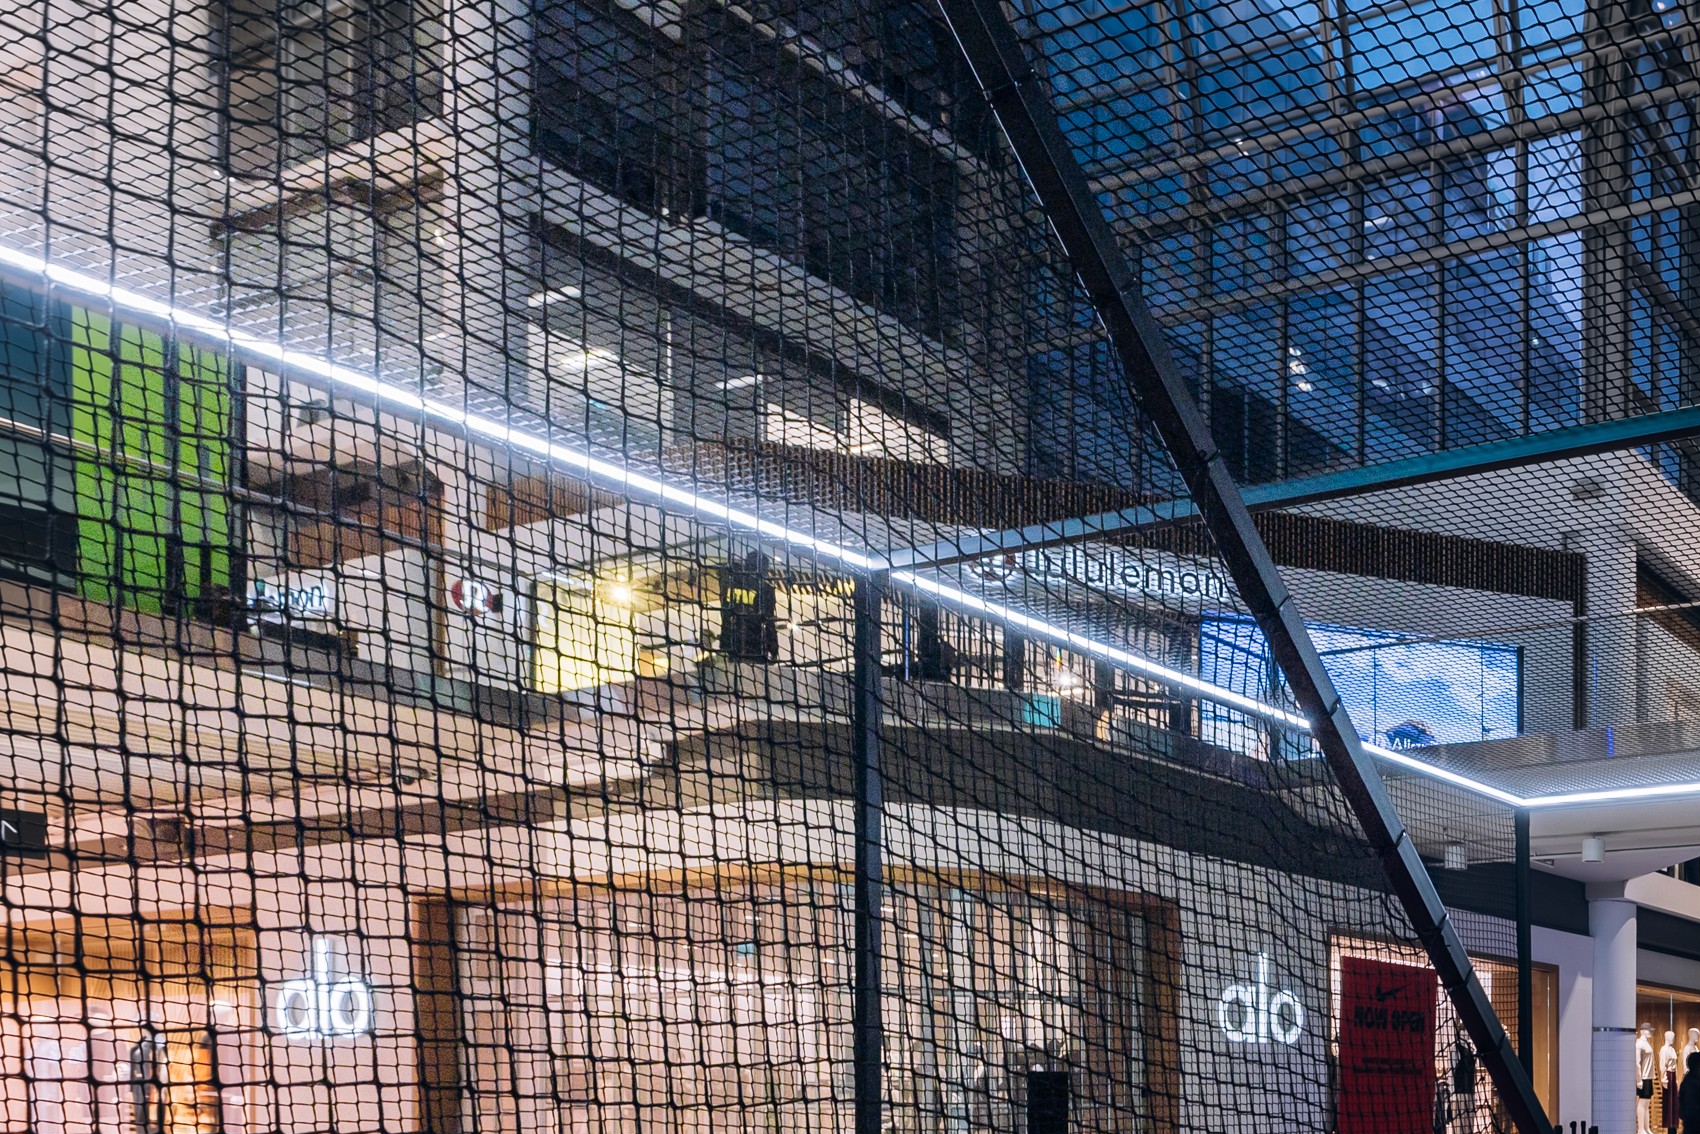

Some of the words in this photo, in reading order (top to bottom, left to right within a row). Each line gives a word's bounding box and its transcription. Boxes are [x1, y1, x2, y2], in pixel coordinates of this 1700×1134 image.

[275, 938, 373, 1041] alo
[1218, 950, 1304, 1046] alo
[1353, 1006, 1388, 1030] NOW
[1391, 1009, 1425, 1033] OPEN
